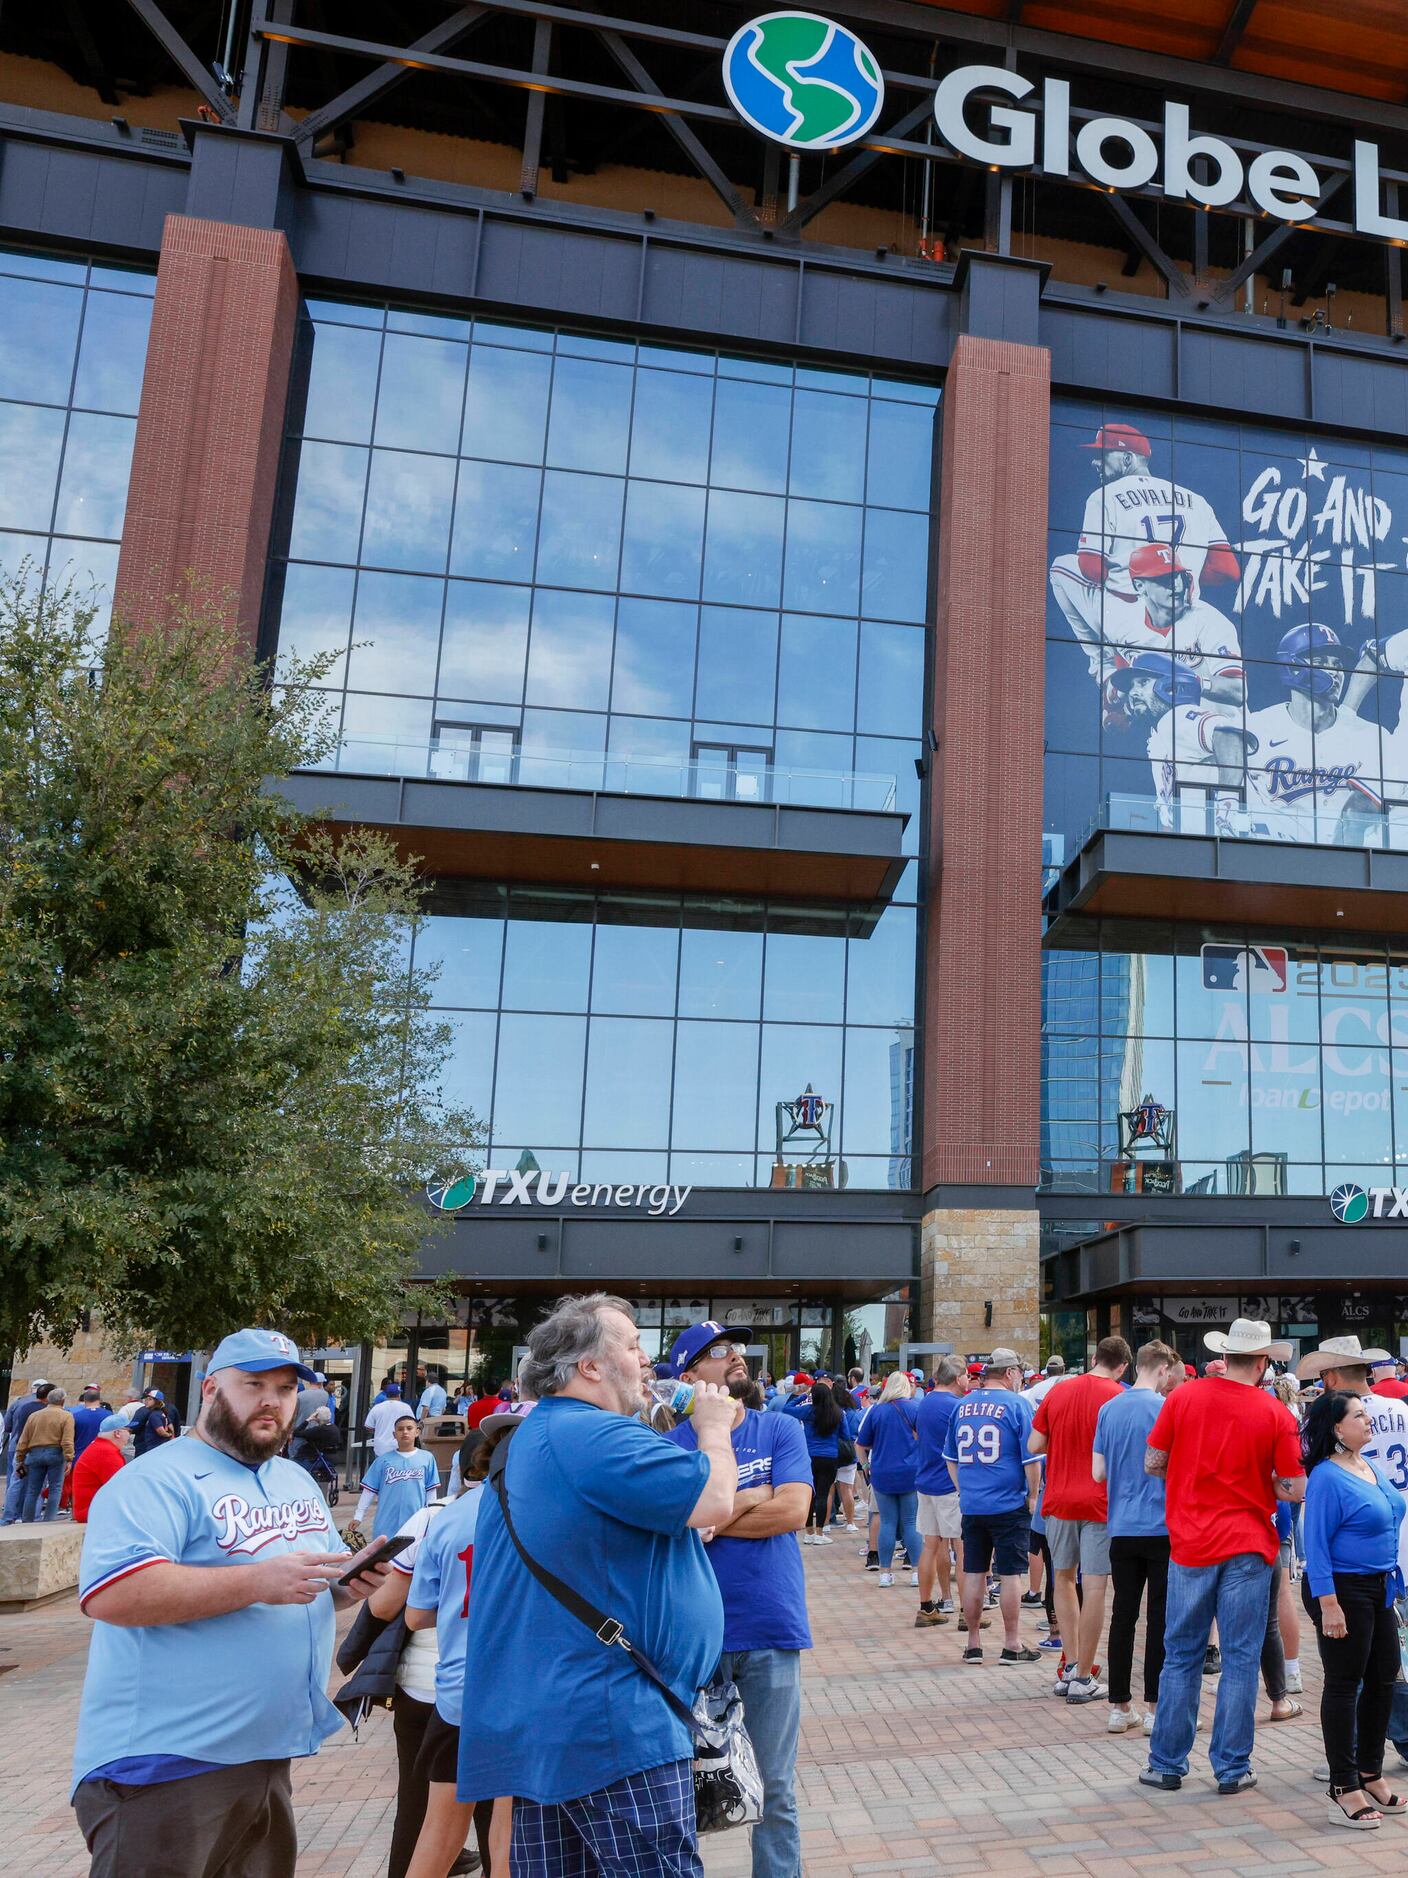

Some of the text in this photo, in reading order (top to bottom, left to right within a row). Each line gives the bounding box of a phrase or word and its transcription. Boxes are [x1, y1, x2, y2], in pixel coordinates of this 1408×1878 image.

[932, 63, 1321, 223] Globe
[1115, 487, 1194, 512] EOVALDI
[1242, 466, 1392, 550] GO AND
[1140, 514, 1187, 551] 17
[1232, 538, 1399, 627] TAKE IT
[1265, 755, 1358, 804] Range
[480, 1168, 693, 1216] TXU energy
[1341, 1305, 1370, 1316] ALCS
[958, 1403, 1005, 1419] BELTRE
[1370, 1407, 1406, 1433] RCÍA
[957, 1424, 1001, 1464] 29
[385, 1466, 424, 1485] Rangers
[212, 1493, 329, 1557] Rangers
